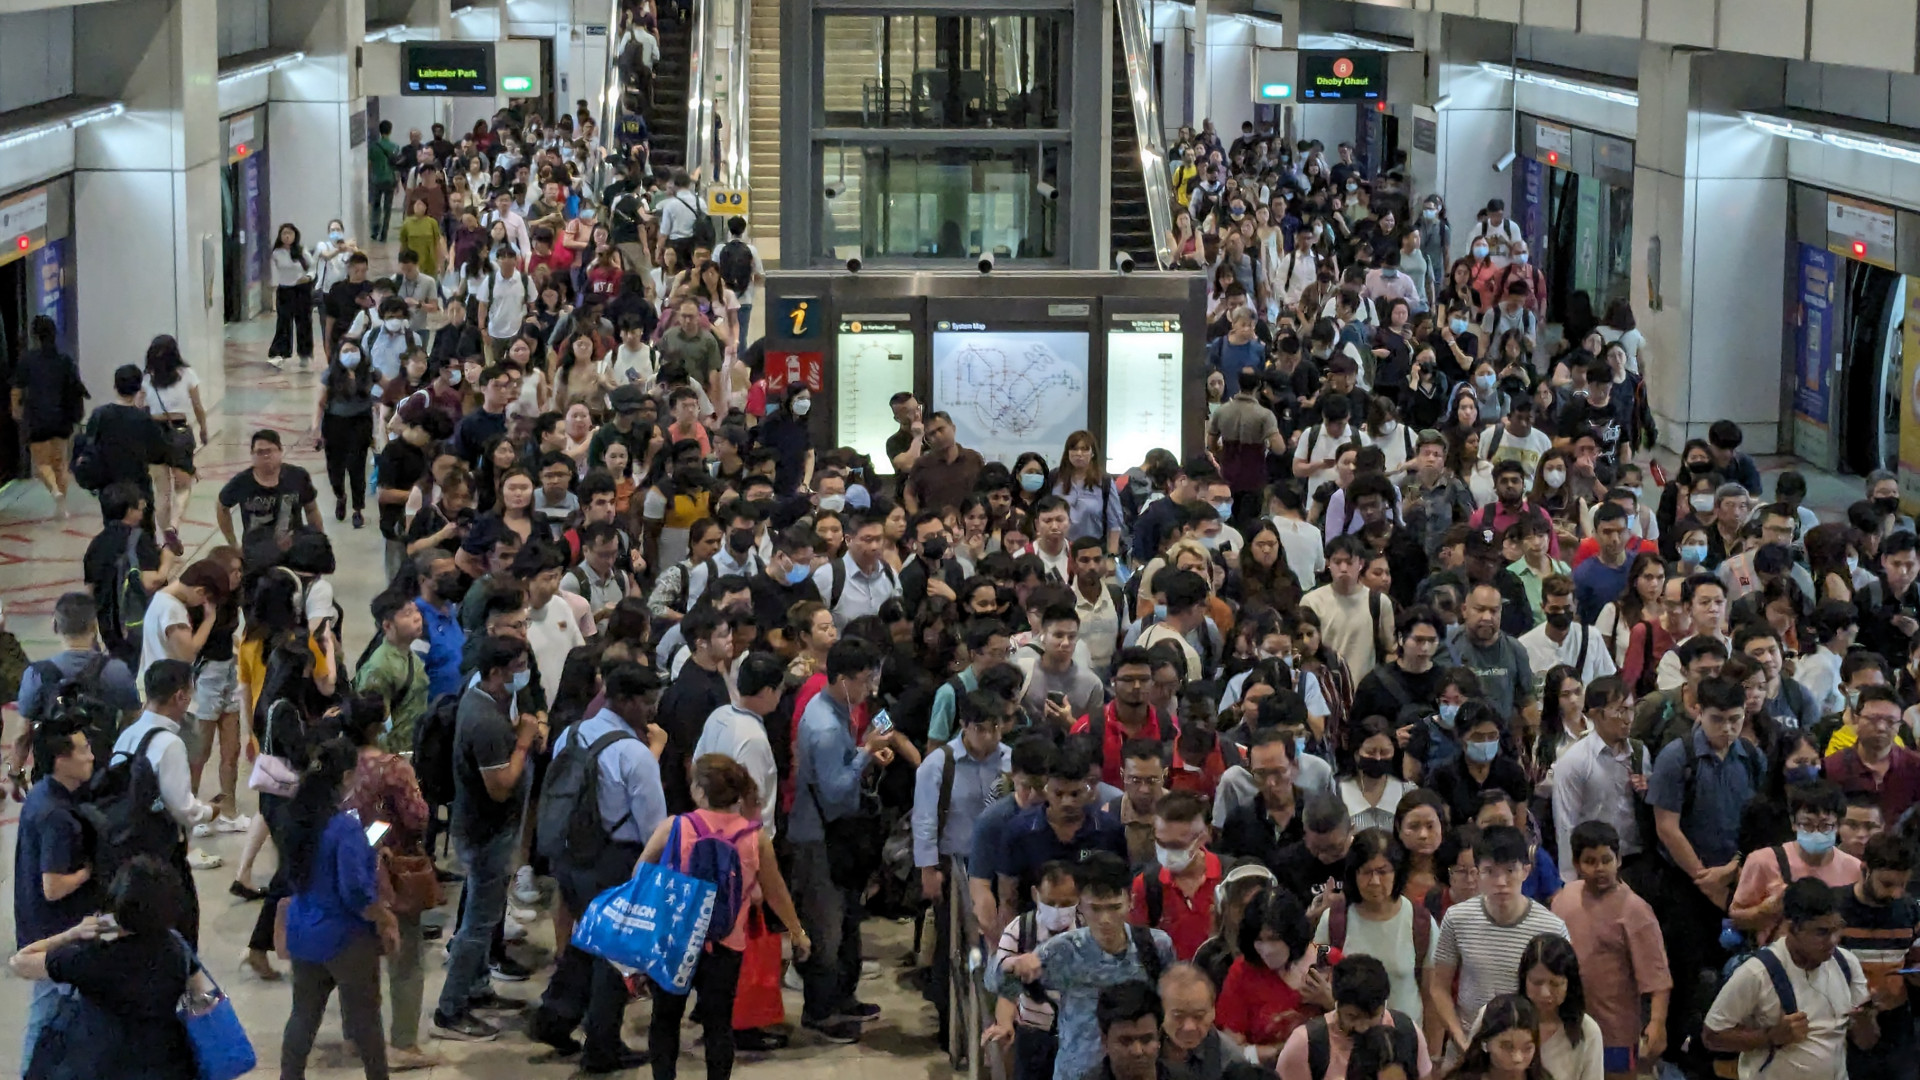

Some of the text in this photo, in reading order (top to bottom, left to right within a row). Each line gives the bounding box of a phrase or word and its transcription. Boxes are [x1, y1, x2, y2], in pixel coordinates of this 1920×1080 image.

[1340, 63, 1347, 72] 8
[418, 69, 477, 78] Labrador Park
[1316, 77, 1368, 86] Dhoby Ghaut
[952, 322, 986, 331] System Map
